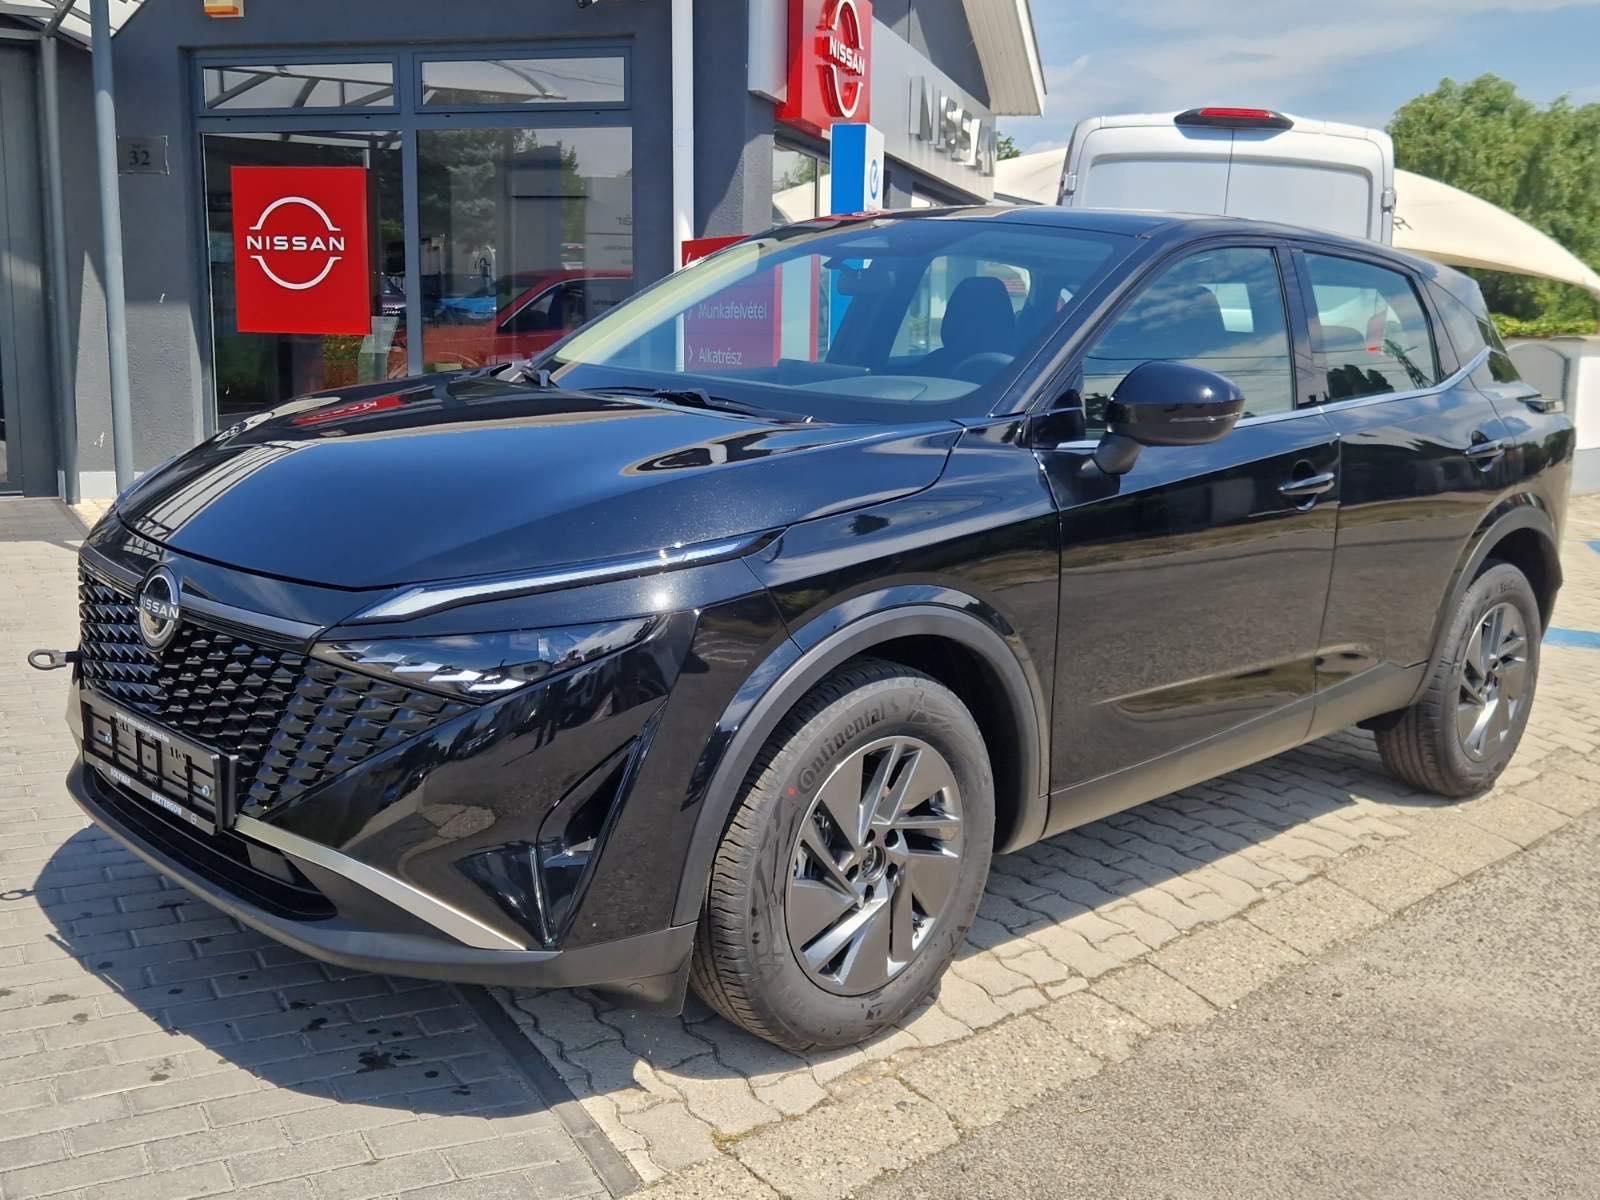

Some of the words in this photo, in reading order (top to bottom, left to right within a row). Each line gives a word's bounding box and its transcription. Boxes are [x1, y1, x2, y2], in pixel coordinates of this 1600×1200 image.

[829, 36, 865, 76] NISSAN
[129, 149, 151, 166] 32
[246, 235, 345, 251] NISSAN
[699, 302, 768, 320] Munkafelvétel
[699, 346, 743, 366] Alkatrész
[139, 593, 180, 619] NISSAN
[798, 701, 887, 793] Continental
